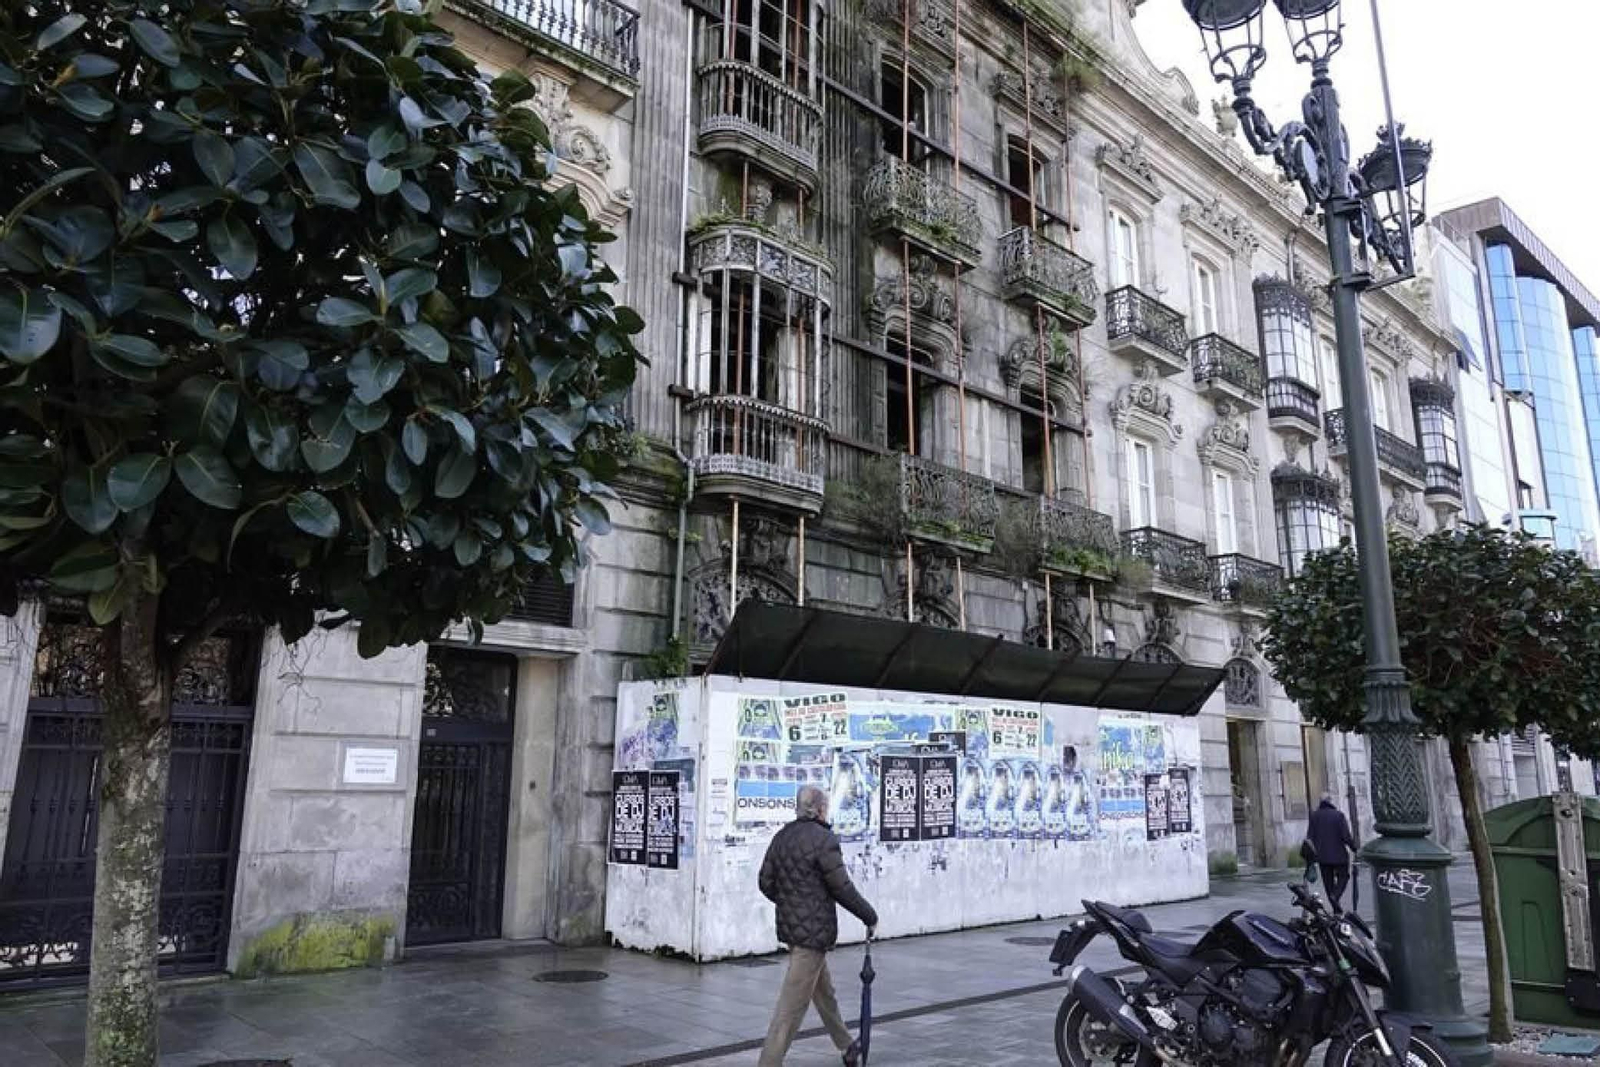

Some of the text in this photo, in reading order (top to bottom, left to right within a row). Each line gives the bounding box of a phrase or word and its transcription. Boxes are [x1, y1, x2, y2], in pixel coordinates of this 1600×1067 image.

[784, 693, 846, 708] VIGO
[992, 708, 1038, 719] VIGO
[789, 726, 801, 741] 6
[993, 731, 1002, 744] 6
[885, 787, 900, 799] DE
[924, 787, 938, 799] DE
[617, 804, 630, 818] DE
